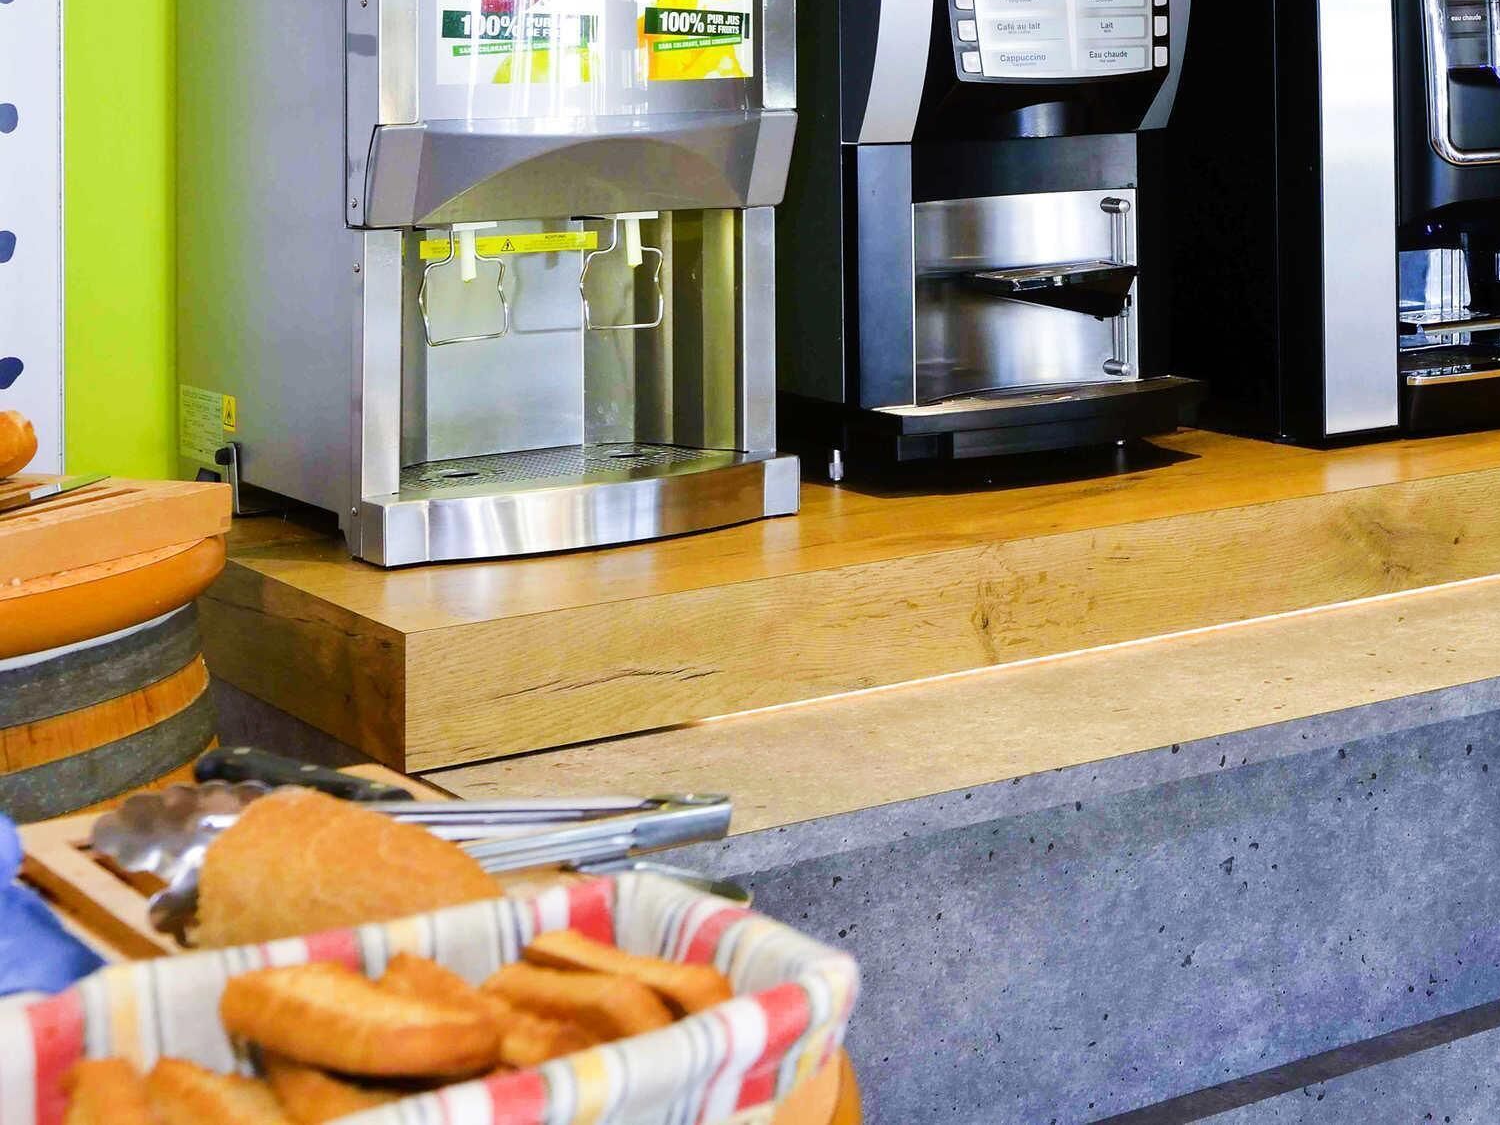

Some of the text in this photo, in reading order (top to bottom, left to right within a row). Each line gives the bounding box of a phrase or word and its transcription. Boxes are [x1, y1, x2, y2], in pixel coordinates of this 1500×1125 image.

[659, 11, 741, 33] 100% PUR JUS
[1100, 21, 1114, 29] Lait
[706, 24, 740, 35] DE FRUITS
[1088, 50, 1129, 59] Eau chaude
